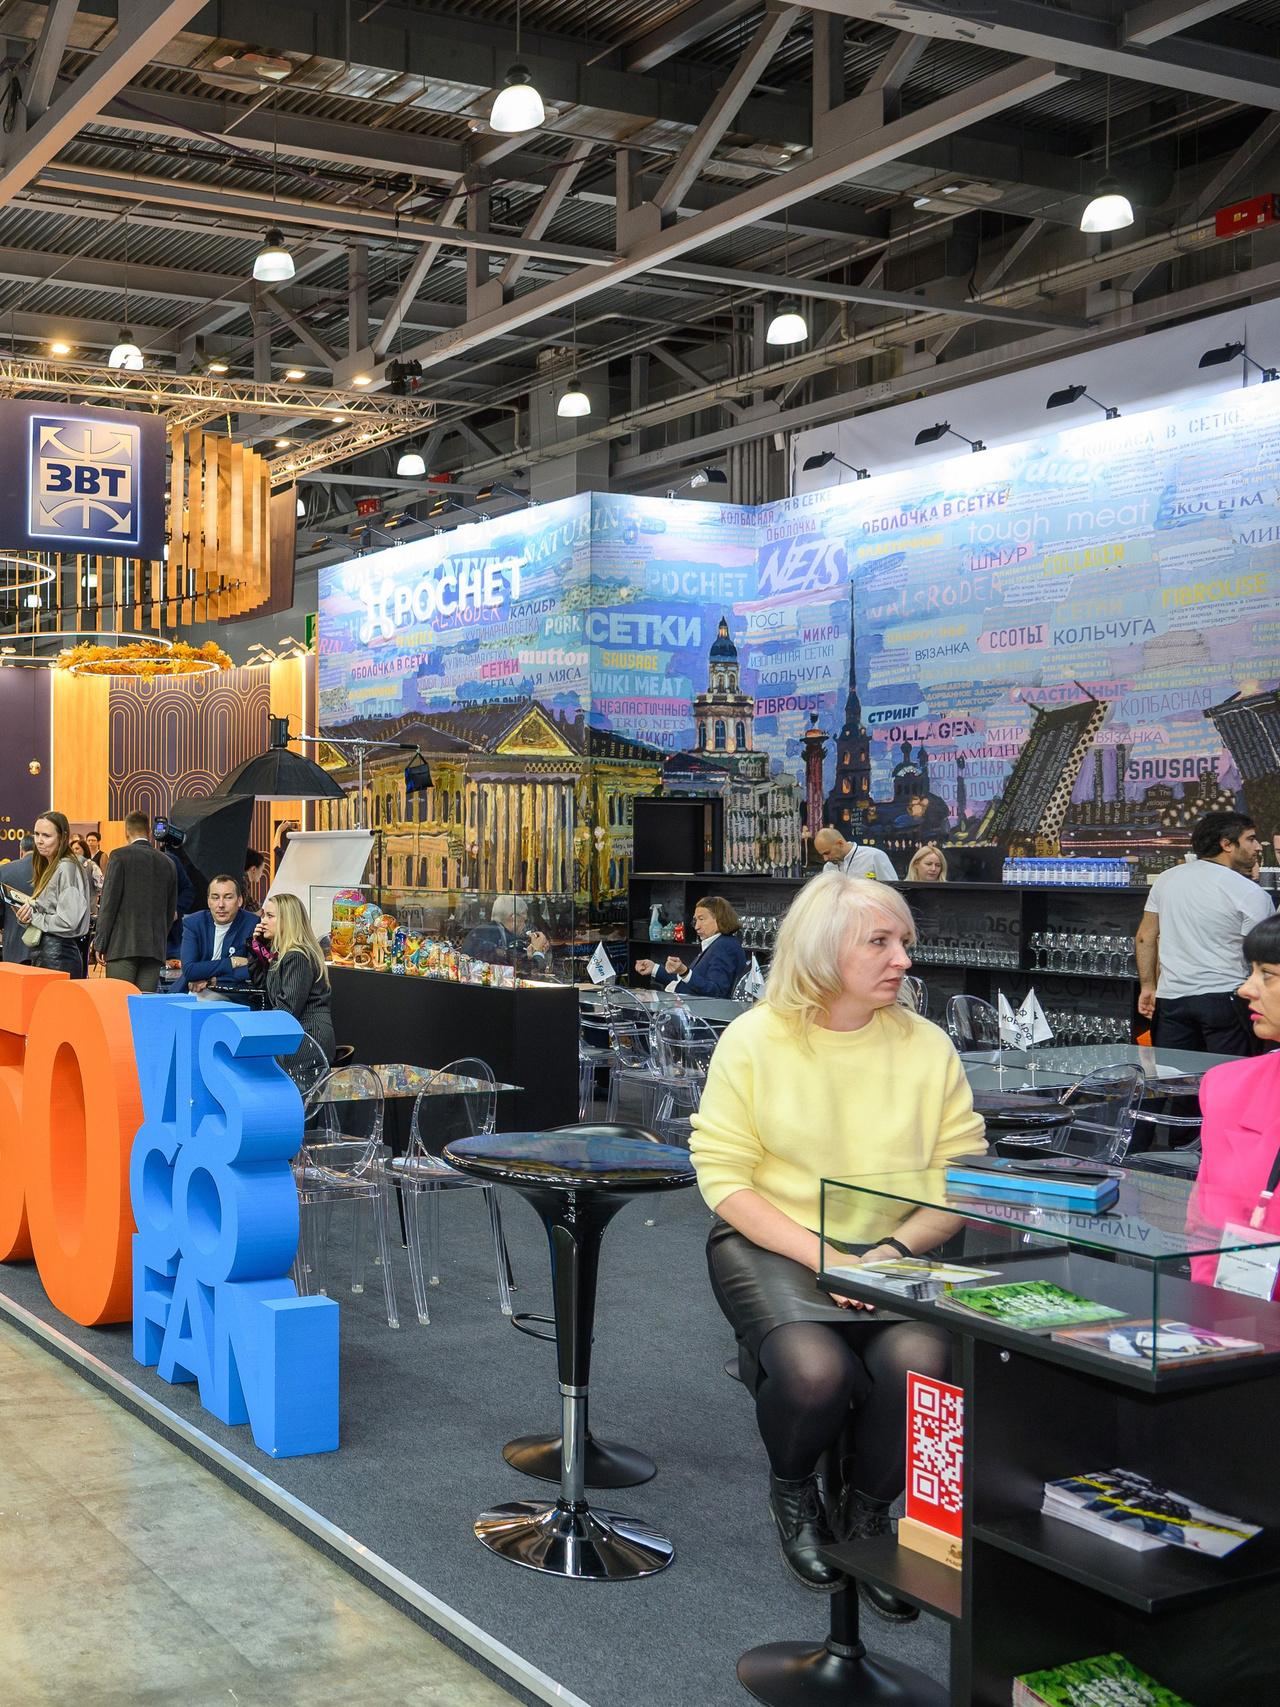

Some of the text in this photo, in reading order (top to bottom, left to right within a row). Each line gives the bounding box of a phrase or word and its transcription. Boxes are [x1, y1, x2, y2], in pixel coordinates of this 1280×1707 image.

[1167, 424, 1177, 439] В
[1189, 409, 1246, 434] СЕТКЕ
[46, 462, 126, 498] ЗВТ
[802, 490, 832, 507] СЕТКЕ
[720, 511, 774, 527] КОЛБАСНАЯ
[862, 488, 1008, 535] ОБОЛОЧКА В СЕТКЕ
[968, 498, 1151, 543] tough meat
[523, 504, 622, 563] NATURIN
[766, 518, 816, 542] ОБОЛОЧКА
[857, 533, 944, 559] ЭЛАСТИЧНЫЕ
[758, 536, 847, 596] NETS
[970, 546, 1027, 571] ШНУР
[1044, 541, 1125, 576] COLLAGEN
[865, 571, 1005, 620] WALSRODER
[1162, 572, 1269, 609] FIBROUSE
[510, 599, 556, 620] КАЛИБР
[750, 611, 785, 628] ГОСТ
[1057, 597, 1124, 623] СЕТКИ
[515, 616, 540, 634] СЕТКА
[544, 615, 581, 636] PORK
[585, 612, 701, 647] СЕТКИ
[803, 625, 840, 643] МИКРО
[1053, 618, 1156, 646] КОЛЬЧУГА
[990, 624, 1043, 649] ССОТЫ
[518, 647, 589, 666] mutton
[602, 651, 659, 671] SAUSAGE
[805, 644, 834, 661] СЕТКА
[915, 641, 970, 661] ВЯЗАНКА
[351, 661, 405, 680] ОБОЛОЧКА В
[482, 658, 520, 679] СЕТКИ
[548, 666, 582, 683] МЯСА
[761, 665, 832, 684] КОЛЬЧУГА
[591, 672, 684, 697] WIKI MEAT
[1015, 683, 1129, 704] ЭЛАСТИЧНЫЕ
[756, 693, 825, 715] FIBROUSE
[1120, 688, 1213, 717] КОЛБАСНАЯ
[613, 717, 686, 730] TRIO NETS
[867, 706, 919, 724] СТРИНГ
[884, 720, 976, 742] OLLAGEN
[987, 726, 1024, 742] МИР
[1096, 731, 1163, 744] ВЯЗАНКА
[1128, 756, 1220, 780] SAUSAGE
